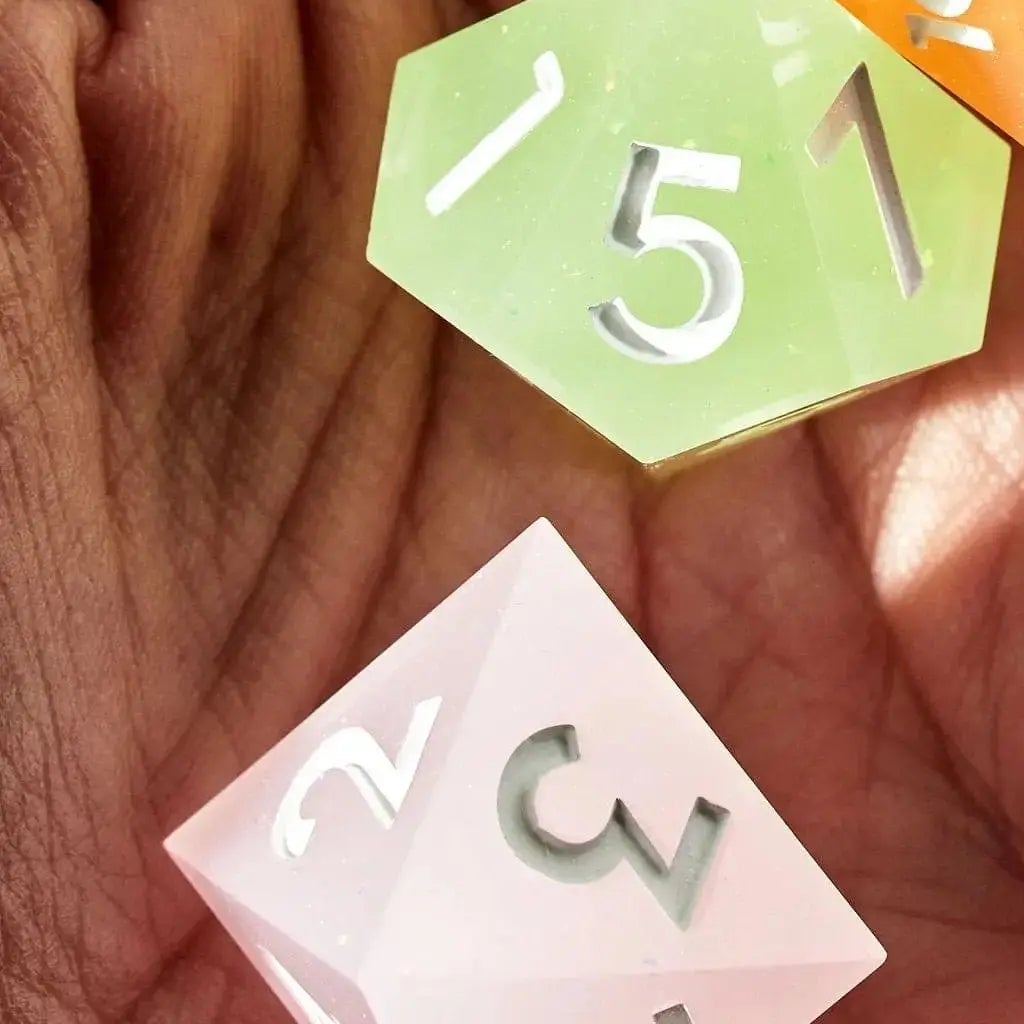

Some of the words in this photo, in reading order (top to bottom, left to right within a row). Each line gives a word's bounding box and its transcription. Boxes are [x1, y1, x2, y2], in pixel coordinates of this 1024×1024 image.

[588, 140, 745, 365] 5
[271, 695, 443, 860] 2
[497, 723, 731, 932] 3
